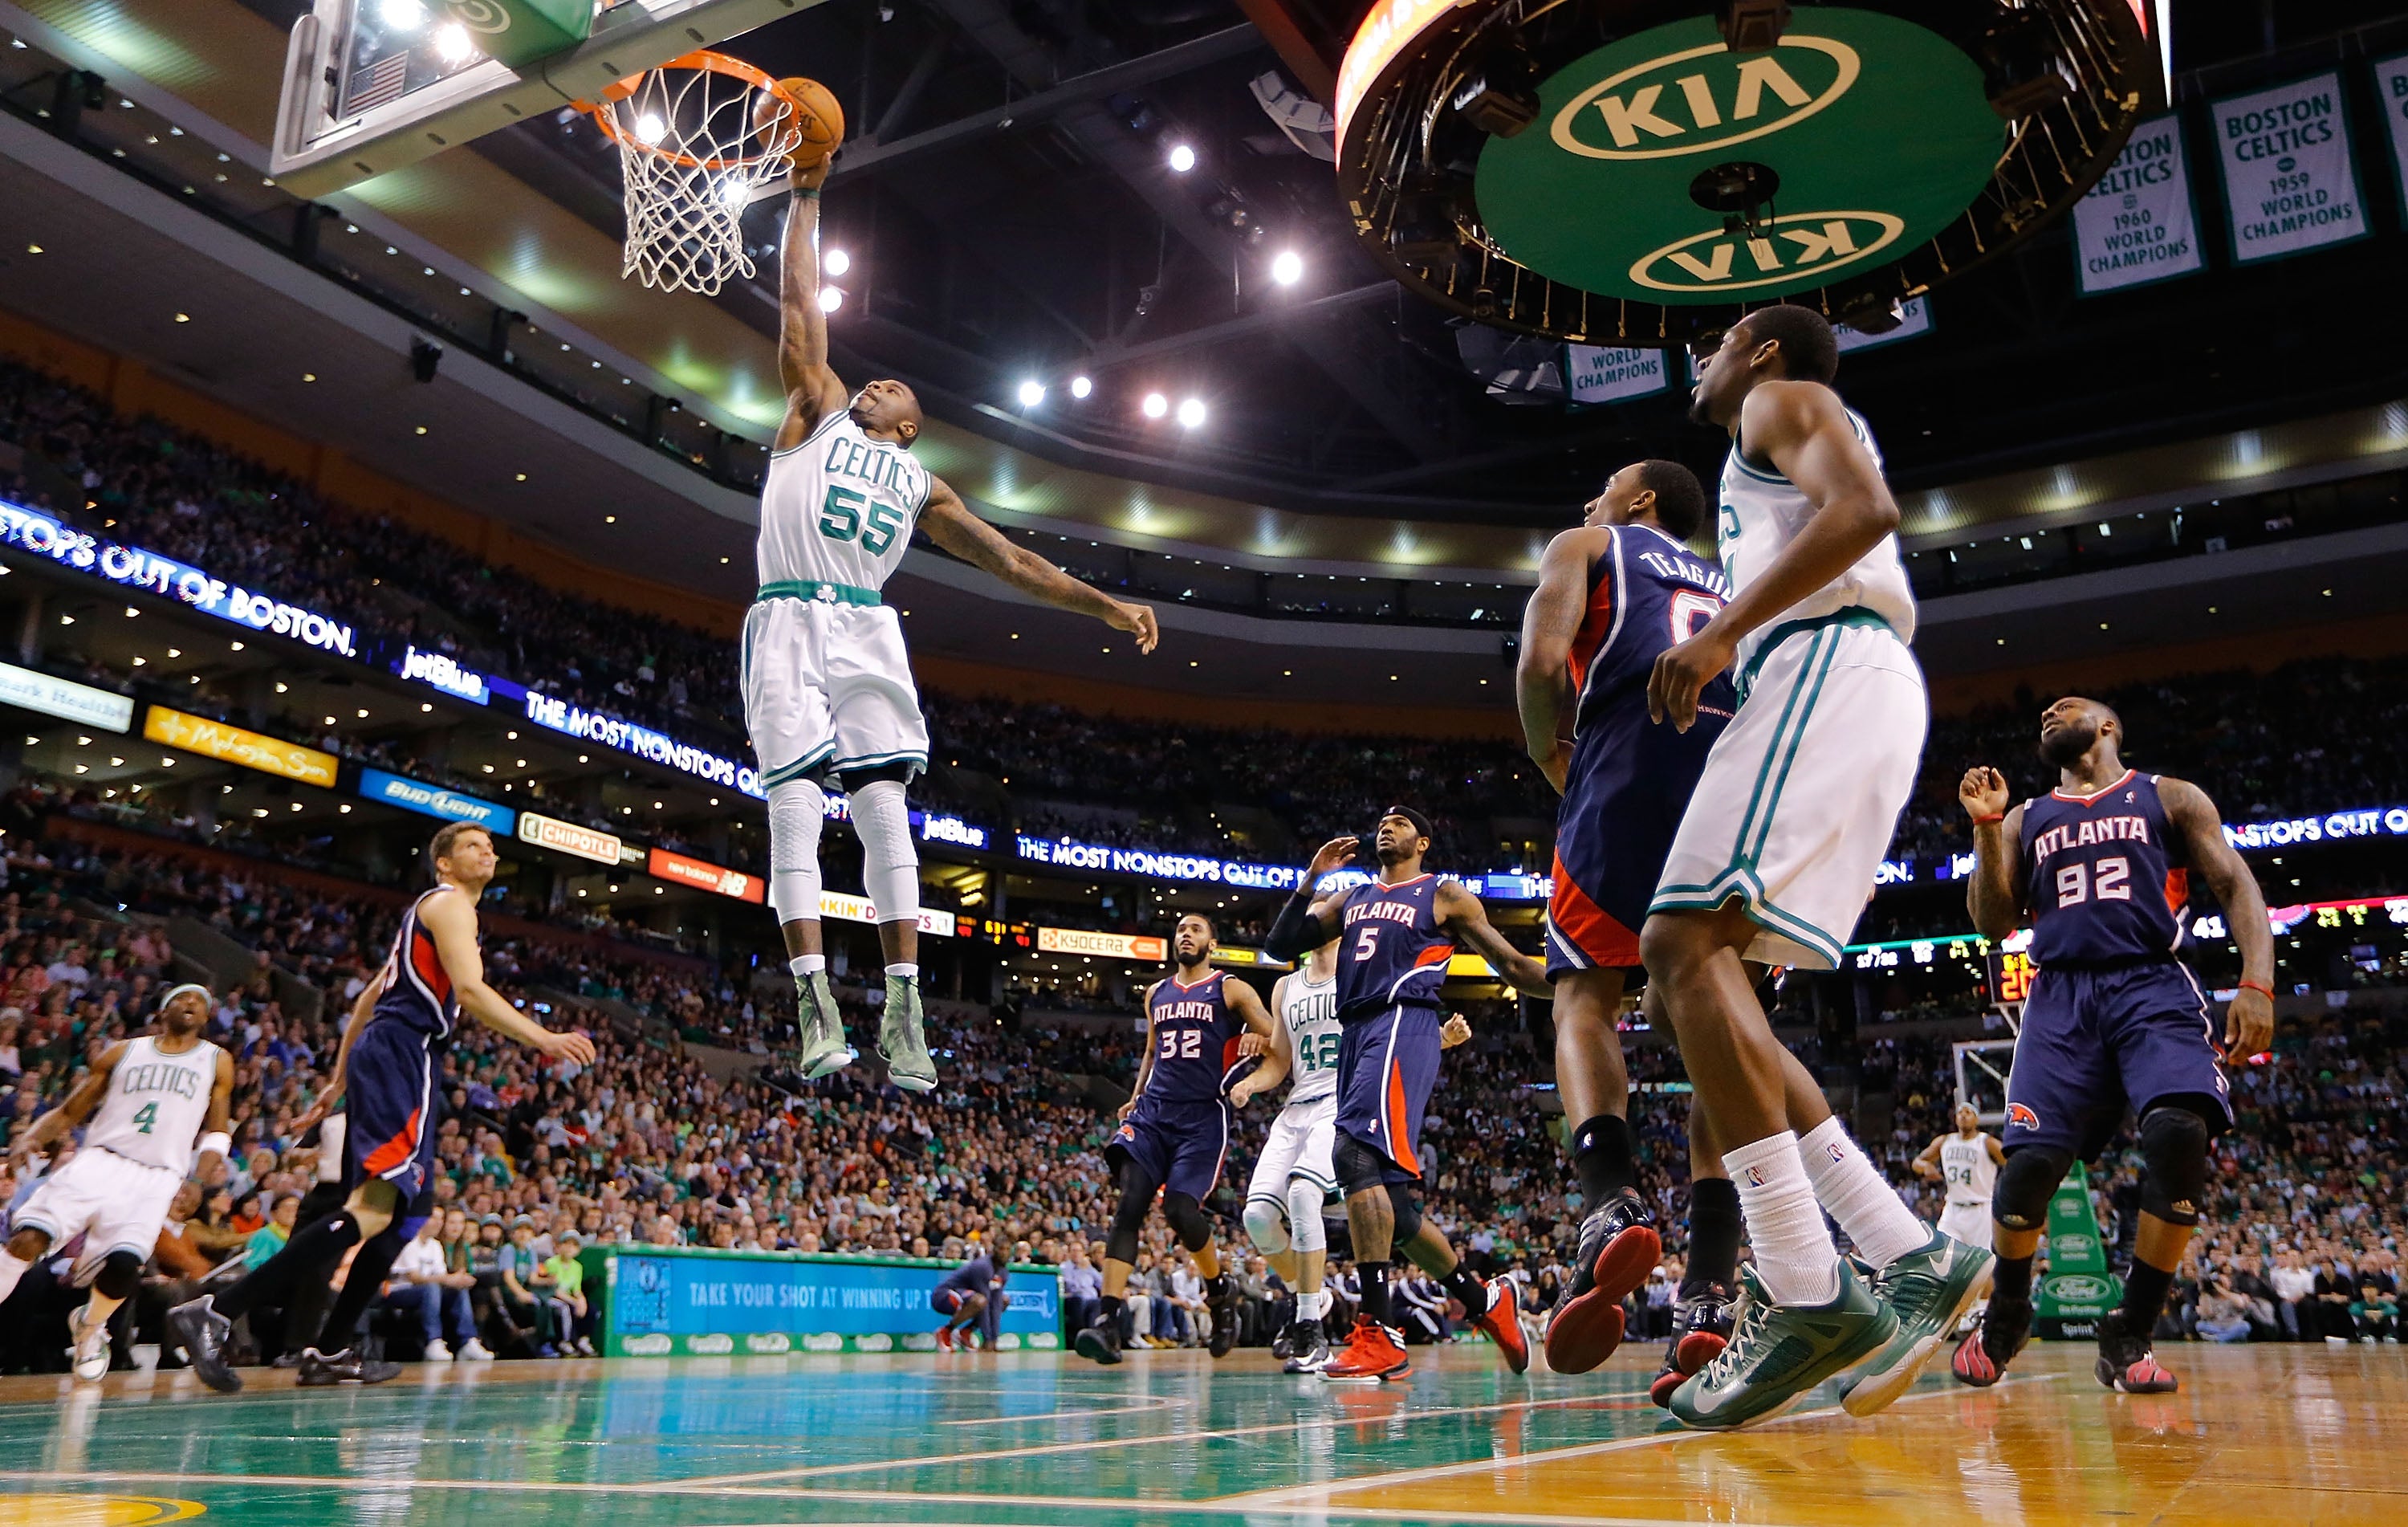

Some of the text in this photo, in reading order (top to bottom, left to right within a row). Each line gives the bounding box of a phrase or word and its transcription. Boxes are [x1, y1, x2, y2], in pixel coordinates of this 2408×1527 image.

[2226, 93, 2332, 139] BOSTON
[2112, 134, 2172, 167] TON
[2235, 120, 2333, 162] CELTICS
[2269, 172, 2310, 195] 1959
[2113, 209, 2152, 230] 1960
[2243, 203, 2353, 240] CHAMPIONS
[2260, 189, 2328, 218] WORLD
[2088, 238, 2189, 274] CHAMPIONS
[2104, 226, 2166, 251] WORLD
[1576, 360, 1658, 390] CHAMPIONS
[1592, 347, 1641, 370] WORLD
[824, 437, 915, 512] CELTICS
[818, 484, 905, 558] 55
[102, 545, 177, 594] OUT
[177, 572, 228, 609] OF
[229, 585, 357, 658] BOSTON.
[401, 645, 482, 698] jetBlue
[526, 690, 567, 729] THE
[568, 706, 632, 750] MOST
[632, 727, 735, 788] NONSTOPS
[543, 823, 617, 857] CHIPOTLE
[922, 812, 984, 848] jetBlue
[2035, 815, 2150, 866] ATLANTA
[2324, 811, 2381, 838] OUT
[2384, 808, 2408, 833] O
[1017, 836, 1050, 862] THE
[1051, 843, 1109, 869] MOST
[1112, 852, 1220, 882] NONSTOPS
[1222, 864, 1264, 885] OUT
[1267, 866, 1295, 888] OF
[2056, 855, 2131, 910] 92
[1344, 900, 1417, 930] ATLANTA
[1354, 926, 1381, 962] 5
[1153, 1000, 1214, 1026] ATLANTA
[1289, 992, 1338, 1032] CELTIC
[1160, 1028, 1202, 1060] 32
[1300, 1032, 1342, 1072] 42
[123, 1062, 200, 1100] CELTICS
[132, 1101, 160, 1134] 4
[1946, 1166, 1972, 1186] 34
[689, 1282, 727, 1307] TAKE
[731, 1283, 775, 1308] YOUR
[779, 1284, 816, 1309] SHOT
[821, 1286, 838, 1309] AT
[841, 1286, 901, 1310] WINNING
[904, 1289, 920, 1310] UP
